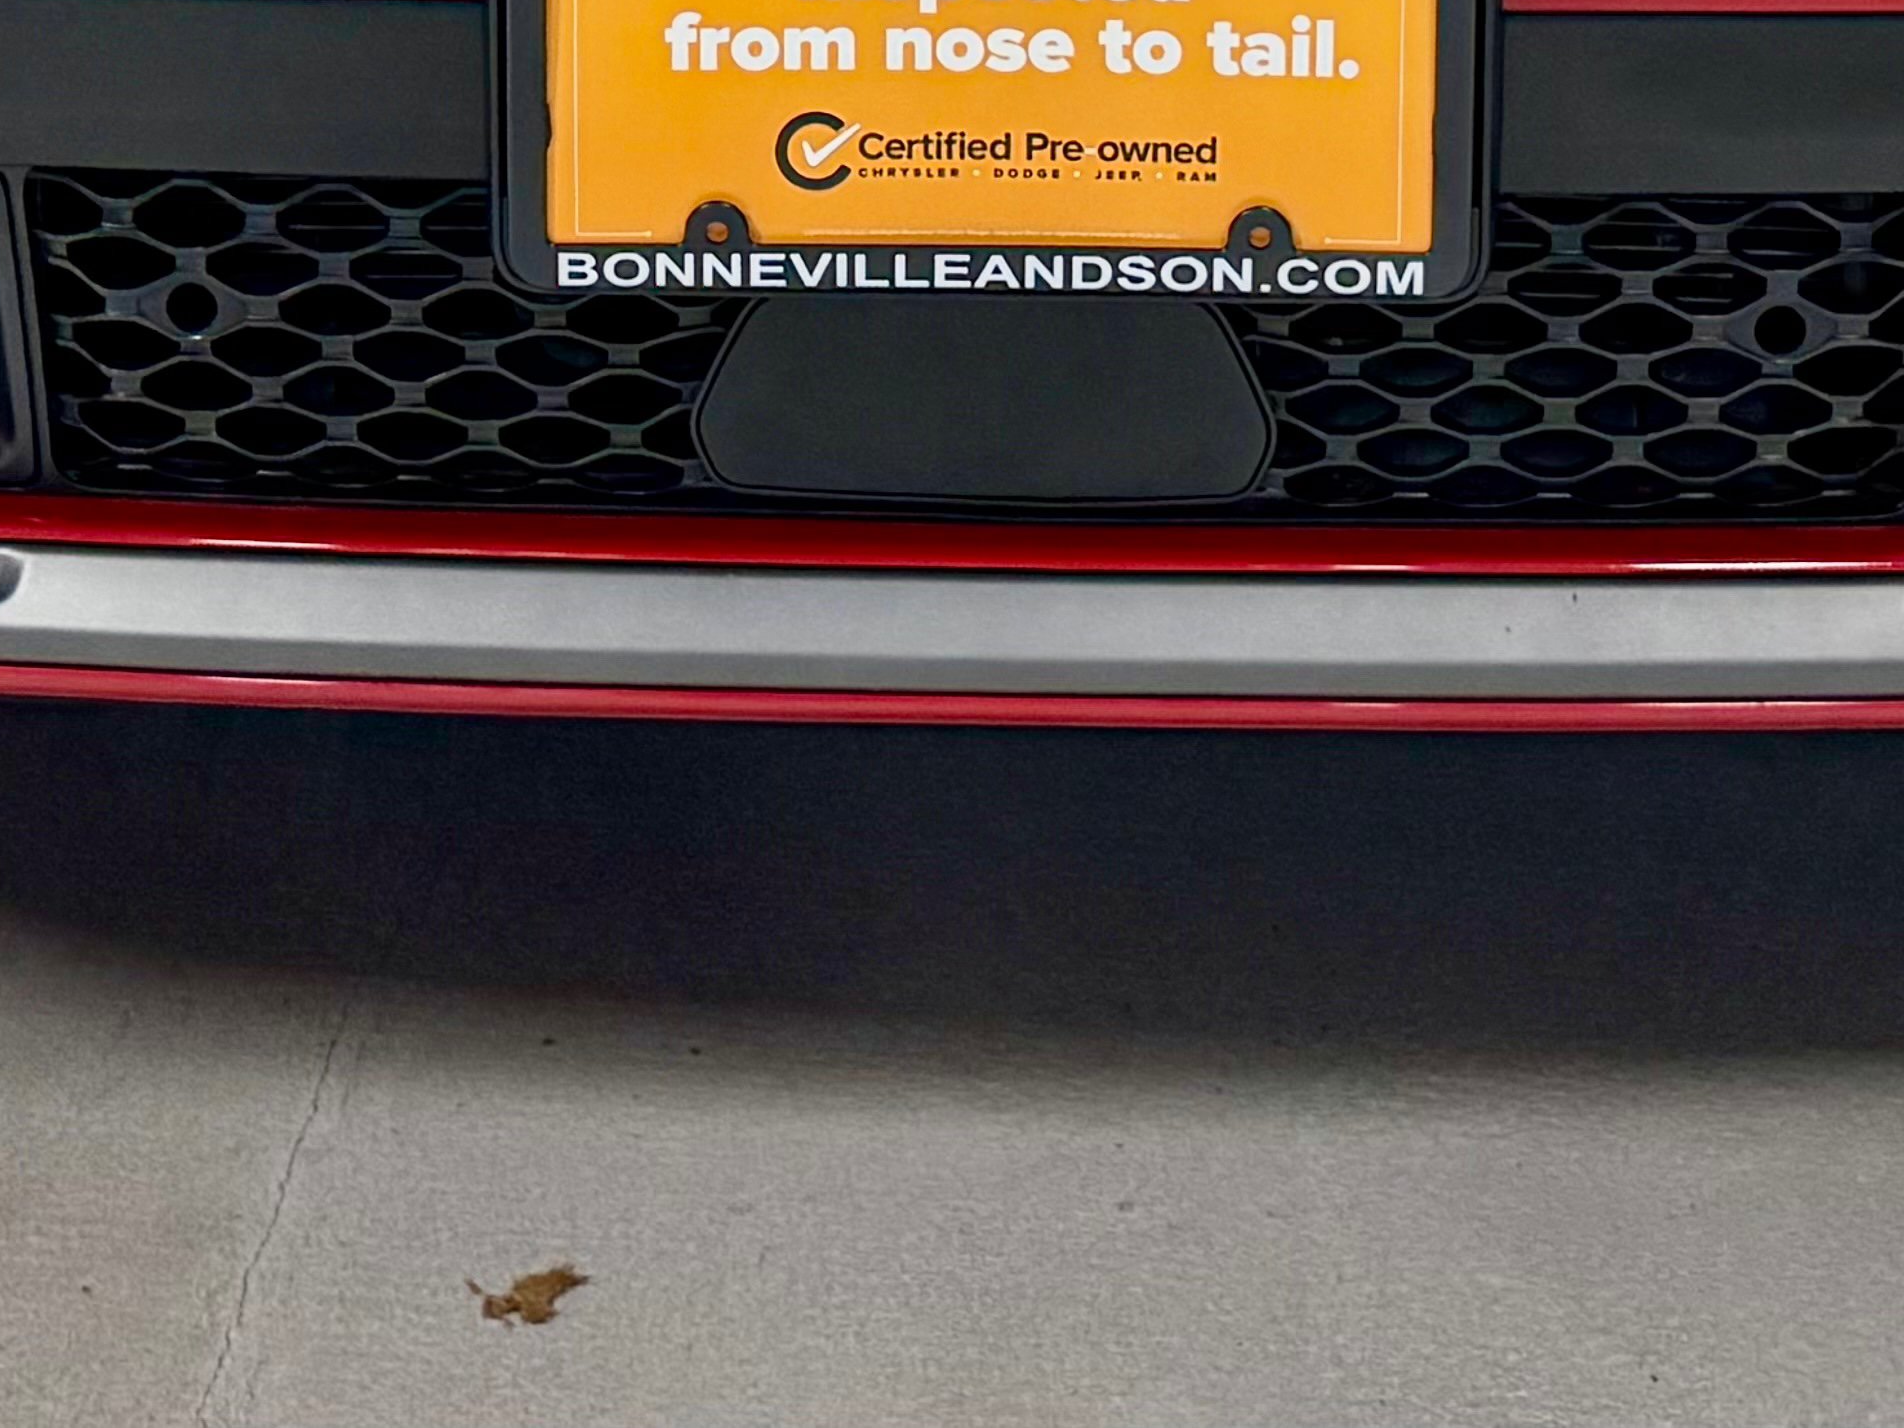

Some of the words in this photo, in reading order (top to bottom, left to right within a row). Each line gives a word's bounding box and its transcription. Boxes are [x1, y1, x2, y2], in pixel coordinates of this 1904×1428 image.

[664, 11, 856, 71] from
[885, 27, 1075, 73] nose
[1098, 19, 1182, 75] to
[1206, 14, 1360, 79] tail.
[858, 132, 1012, 162] Certified
[858, 167, 961, 178] CHRYSLER
[994, 168, 1061, 180] DODGE
[1176, 170, 1218, 182] RAM
[557, 252, 1425, 296] BONNEVILLEANDSON.COM
